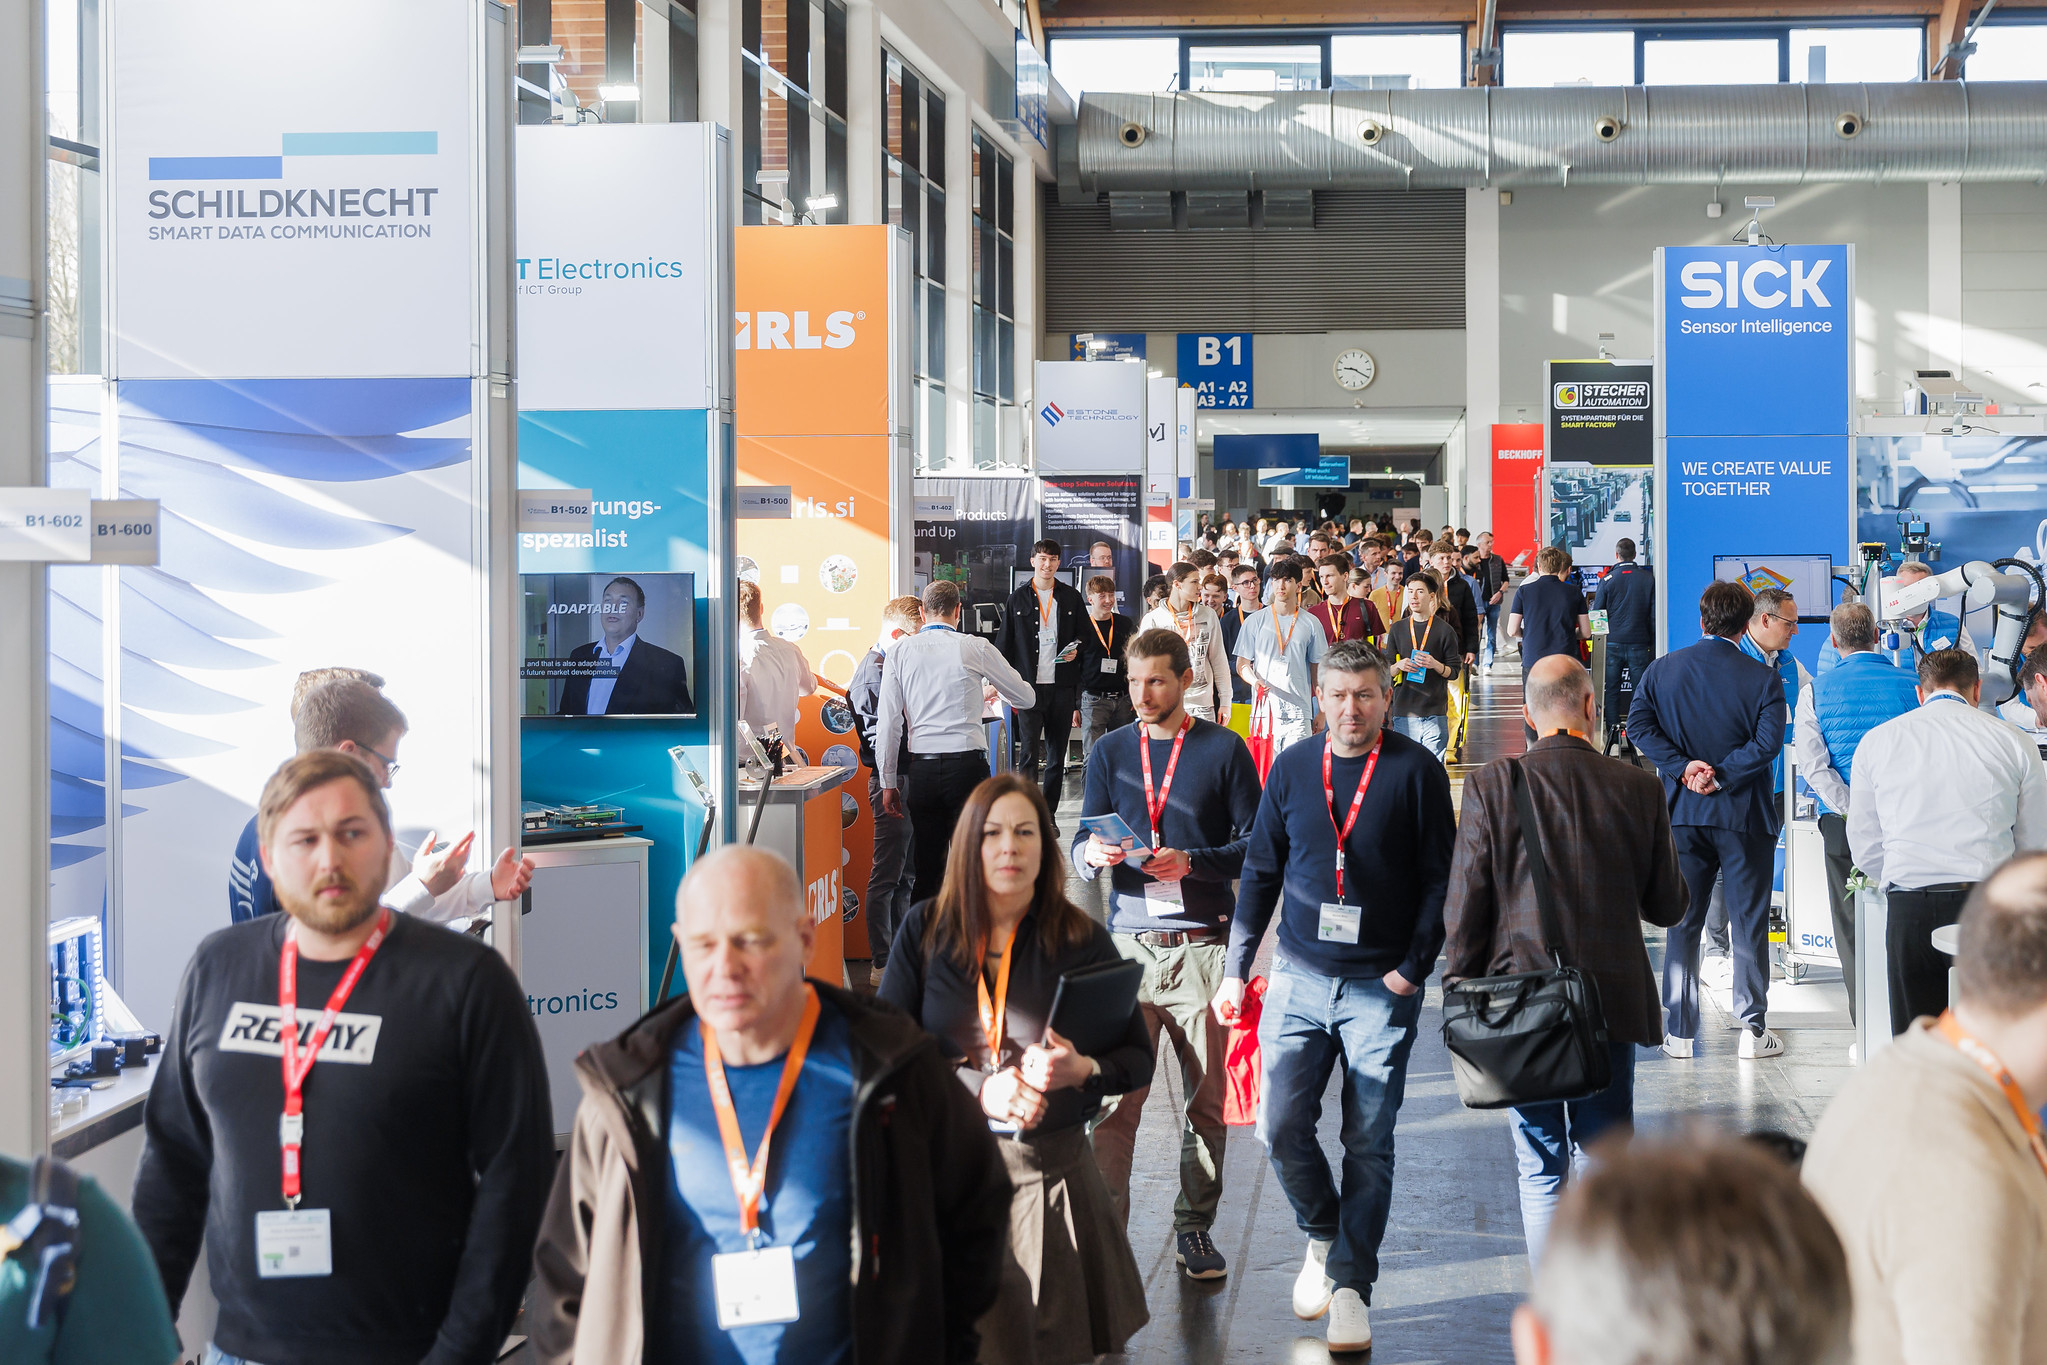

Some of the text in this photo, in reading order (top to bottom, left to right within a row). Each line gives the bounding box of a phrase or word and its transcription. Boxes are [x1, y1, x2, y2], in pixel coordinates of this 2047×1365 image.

[148, 188, 438, 219] SCHILDKNECHT
[148, 223, 430, 240] SMART DATA COMMUNICATION
[538, 256, 683, 280] Electronics
[525, 285, 544, 295] ICT
[547, 284, 582, 296] Group
[1680, 259, 1832, 309] SICK
[1680, 318, 1833, 336] Sensor Intelligence
[1197, 336, 1242, 366] B1
[1197, 381, 1215, 393] A1
[1228, 381, 1247, 393] A2
[1583, 385, 1646, 397] STECHER
[1197, 395, 1216, 407] A3
[1228, 395, 1248, 407] A7
[1583, 398, 1643, 406] AUTOMATION
[1560, 414, 1616, 422] SYSTEMPARTNER
[1617, 413, 1631, 421] FÜR
[1498, 449, 1543, 460] BECKHOFF
[1681, 461, 1832, 476] WE CREATE VALUE
[1681, 481, 1770, 496] TOGETHER
[760, 497, 788, 505] B1-500
[551, 505, 588, 515] B1-502
[956, 508, 1007, 521] Products
[25, 515, 83, 528] B1-602
[97, 523, 152, 536] B1-600
[939, 526, 956, 540] Up
[522, 528, 628, 553] spezialist
[547, 603, 628, 615] ADAPTABLE
[577, 660, 610, 668] adaptable
[1801, 933, 1833, 948] SICK
